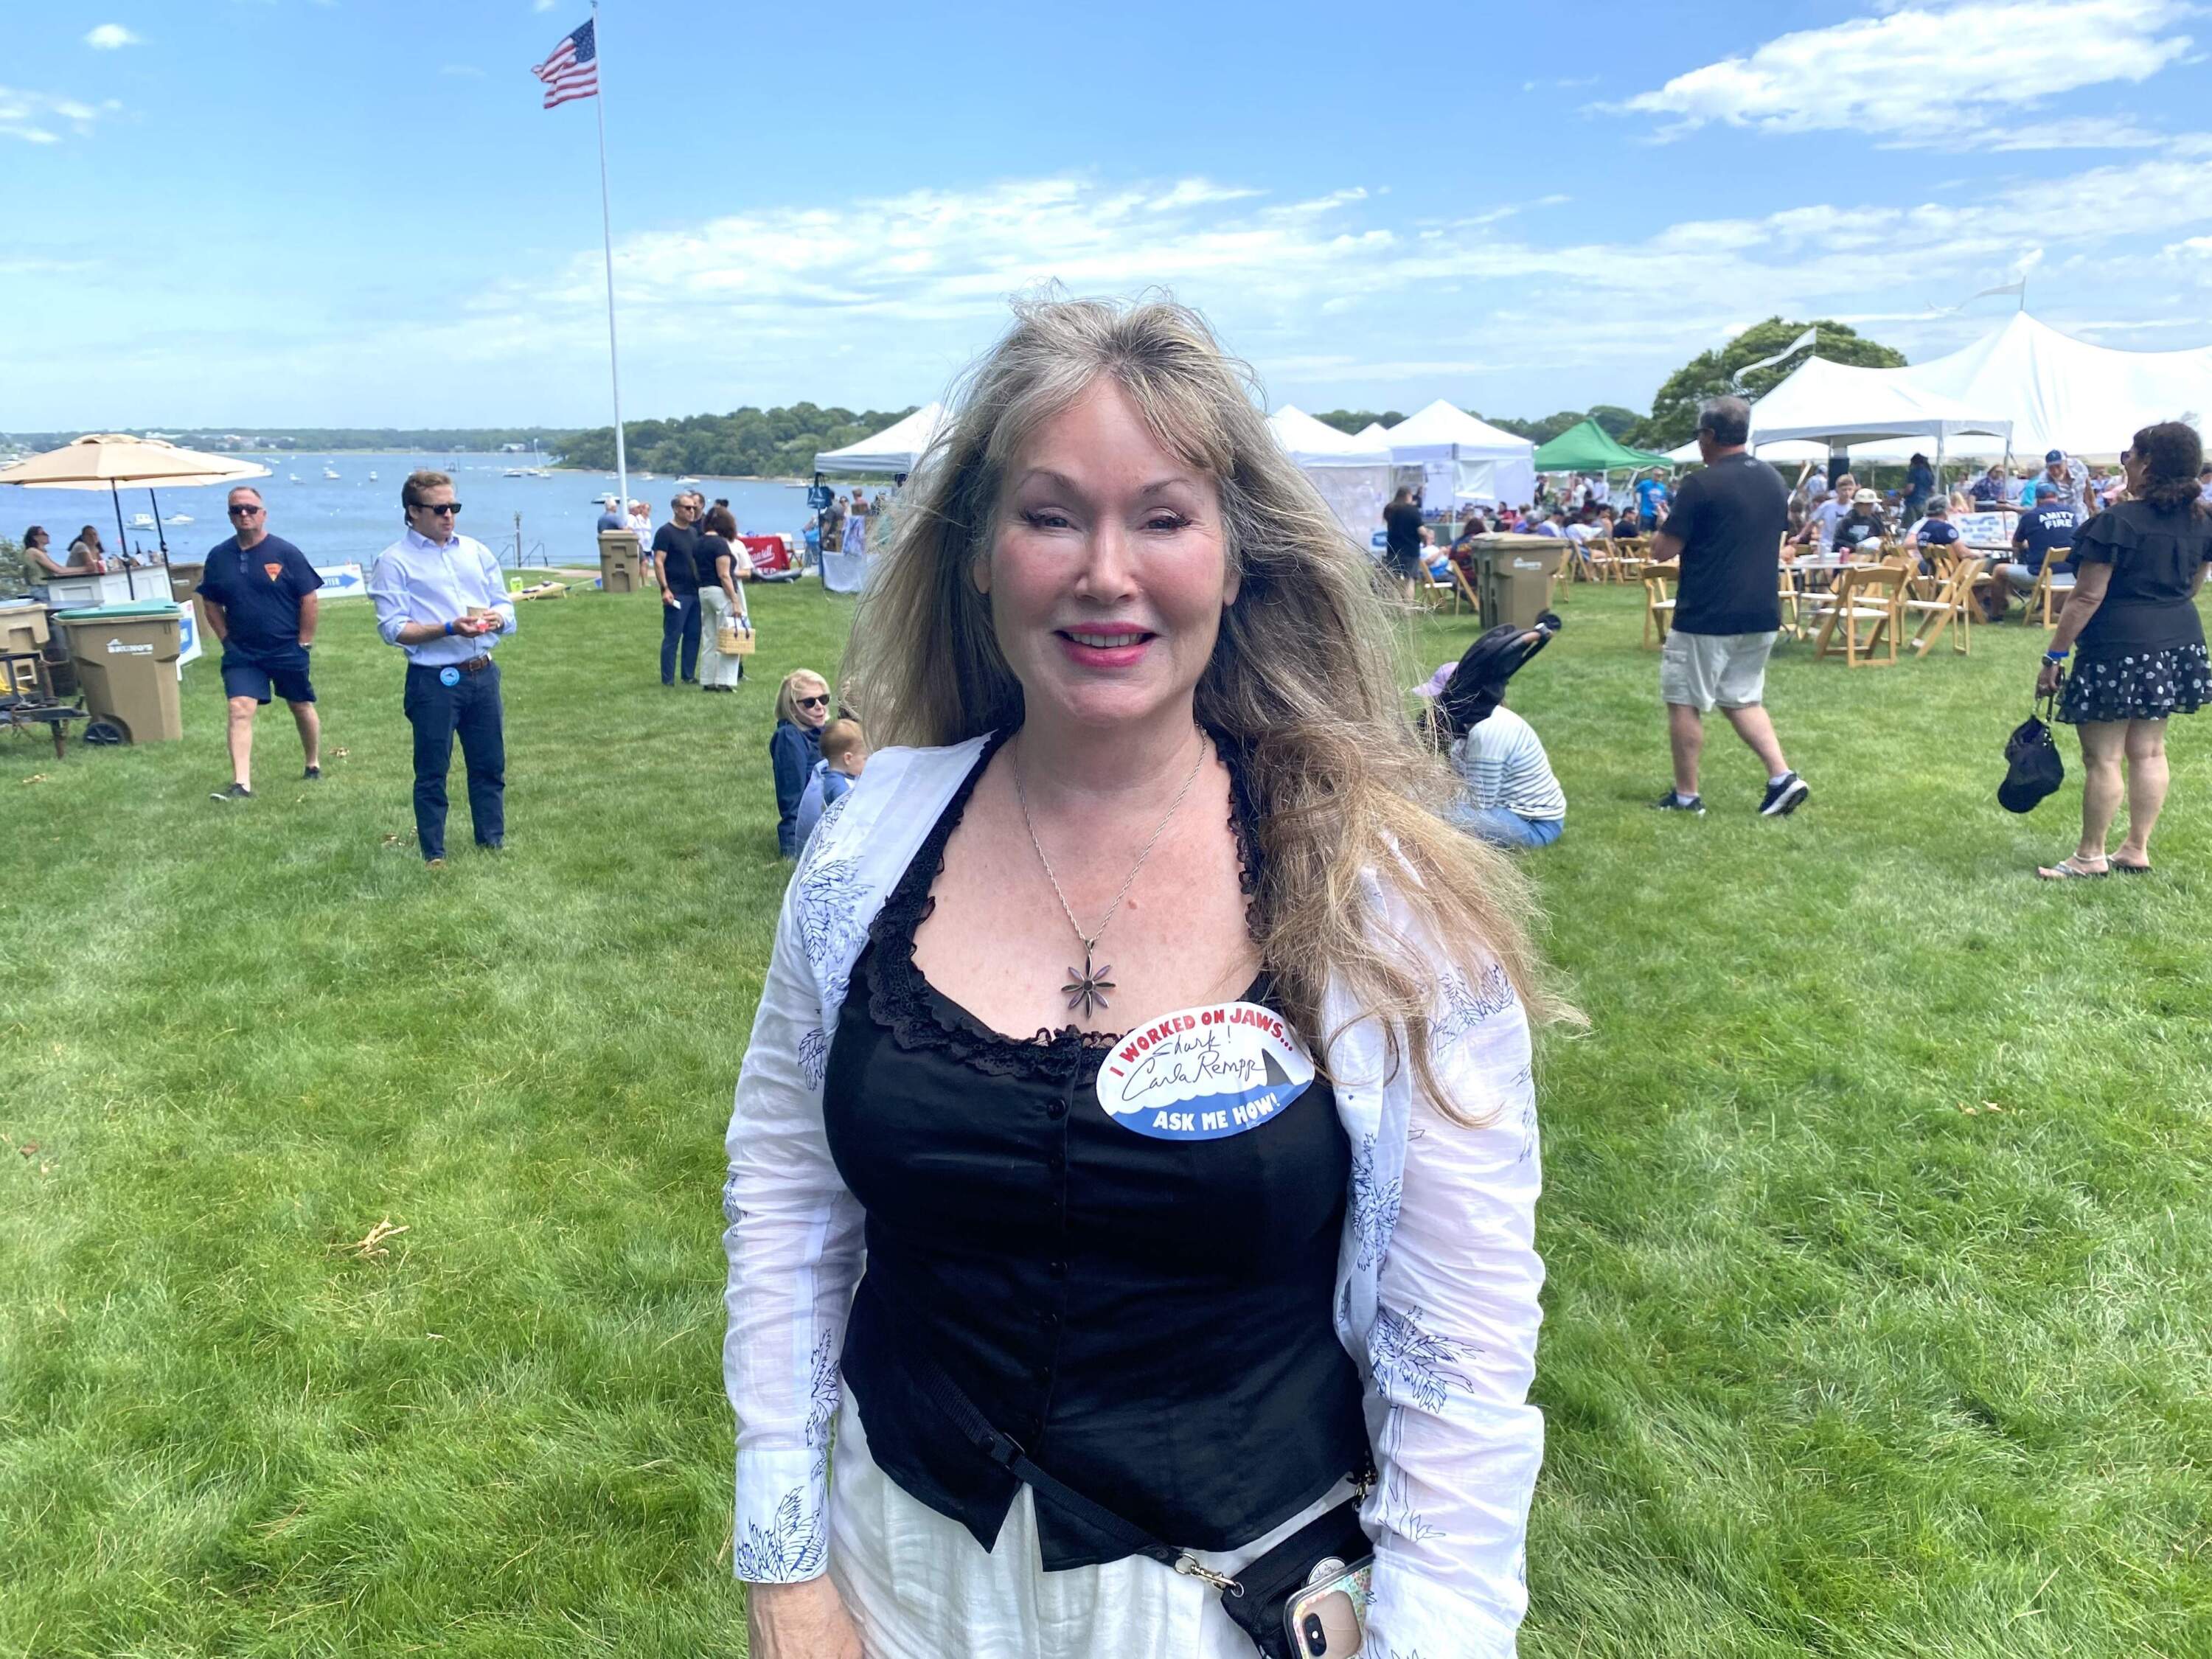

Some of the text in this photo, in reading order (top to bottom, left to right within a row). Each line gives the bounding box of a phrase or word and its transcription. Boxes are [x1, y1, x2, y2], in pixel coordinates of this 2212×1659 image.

[2039, 511, 2074, 523] AMITY
[2044, 518, 2073, 529] FIRE
[1110, 1066, 1124, 1077] I
[1119, 1015, 1195, 1063] WORKED
[1201, 1009, 1225, 1026] ON
[1122, 1057, 1192, 1101] Carla
[1152, 1092, 1281, 1132] ASK ME HOW!
